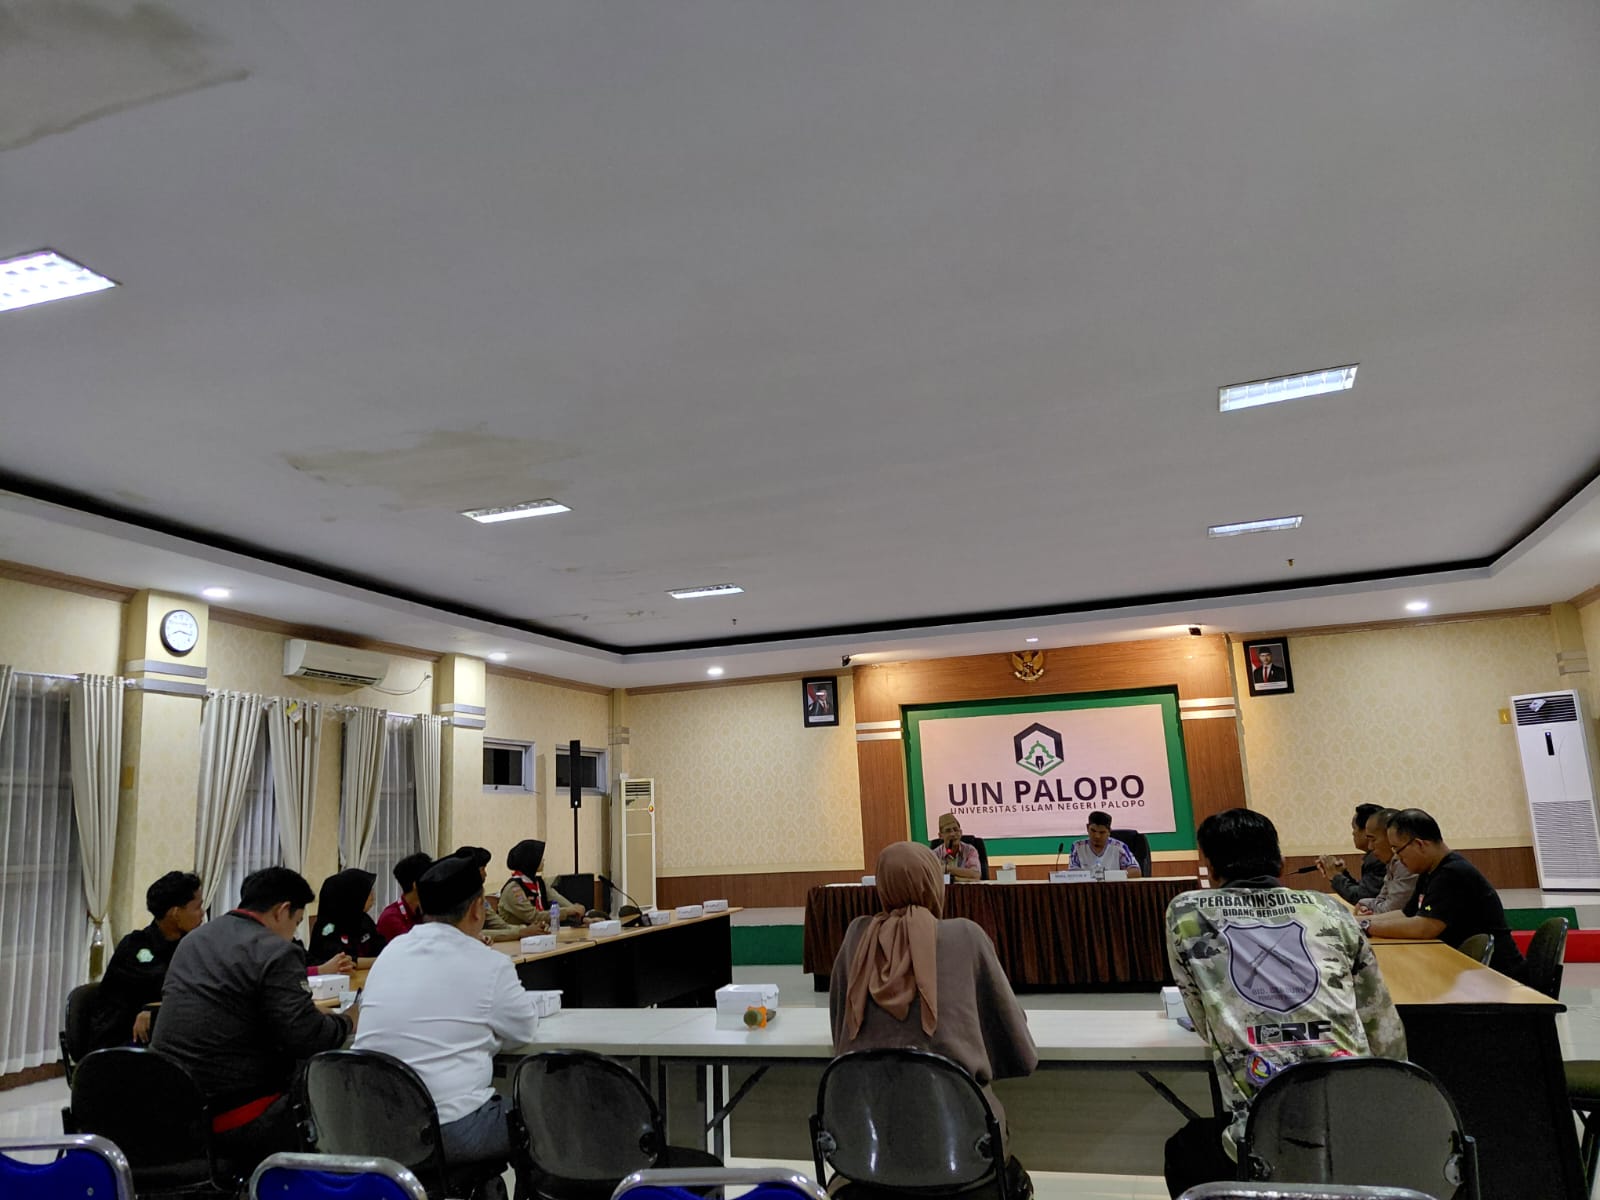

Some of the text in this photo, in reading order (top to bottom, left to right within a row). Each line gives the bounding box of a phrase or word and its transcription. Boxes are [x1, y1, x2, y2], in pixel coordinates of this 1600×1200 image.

[948, 775, 1144, 806] UIN PALOPO
[950, 799, 1145, 815] UNIVERSITAS ISLAM NEGERI PALOPO
[1200, 893, 1314, 908] PERBAKIN SULSEL
[1223, 906, 1296, 918] BIDANG BERBURU
